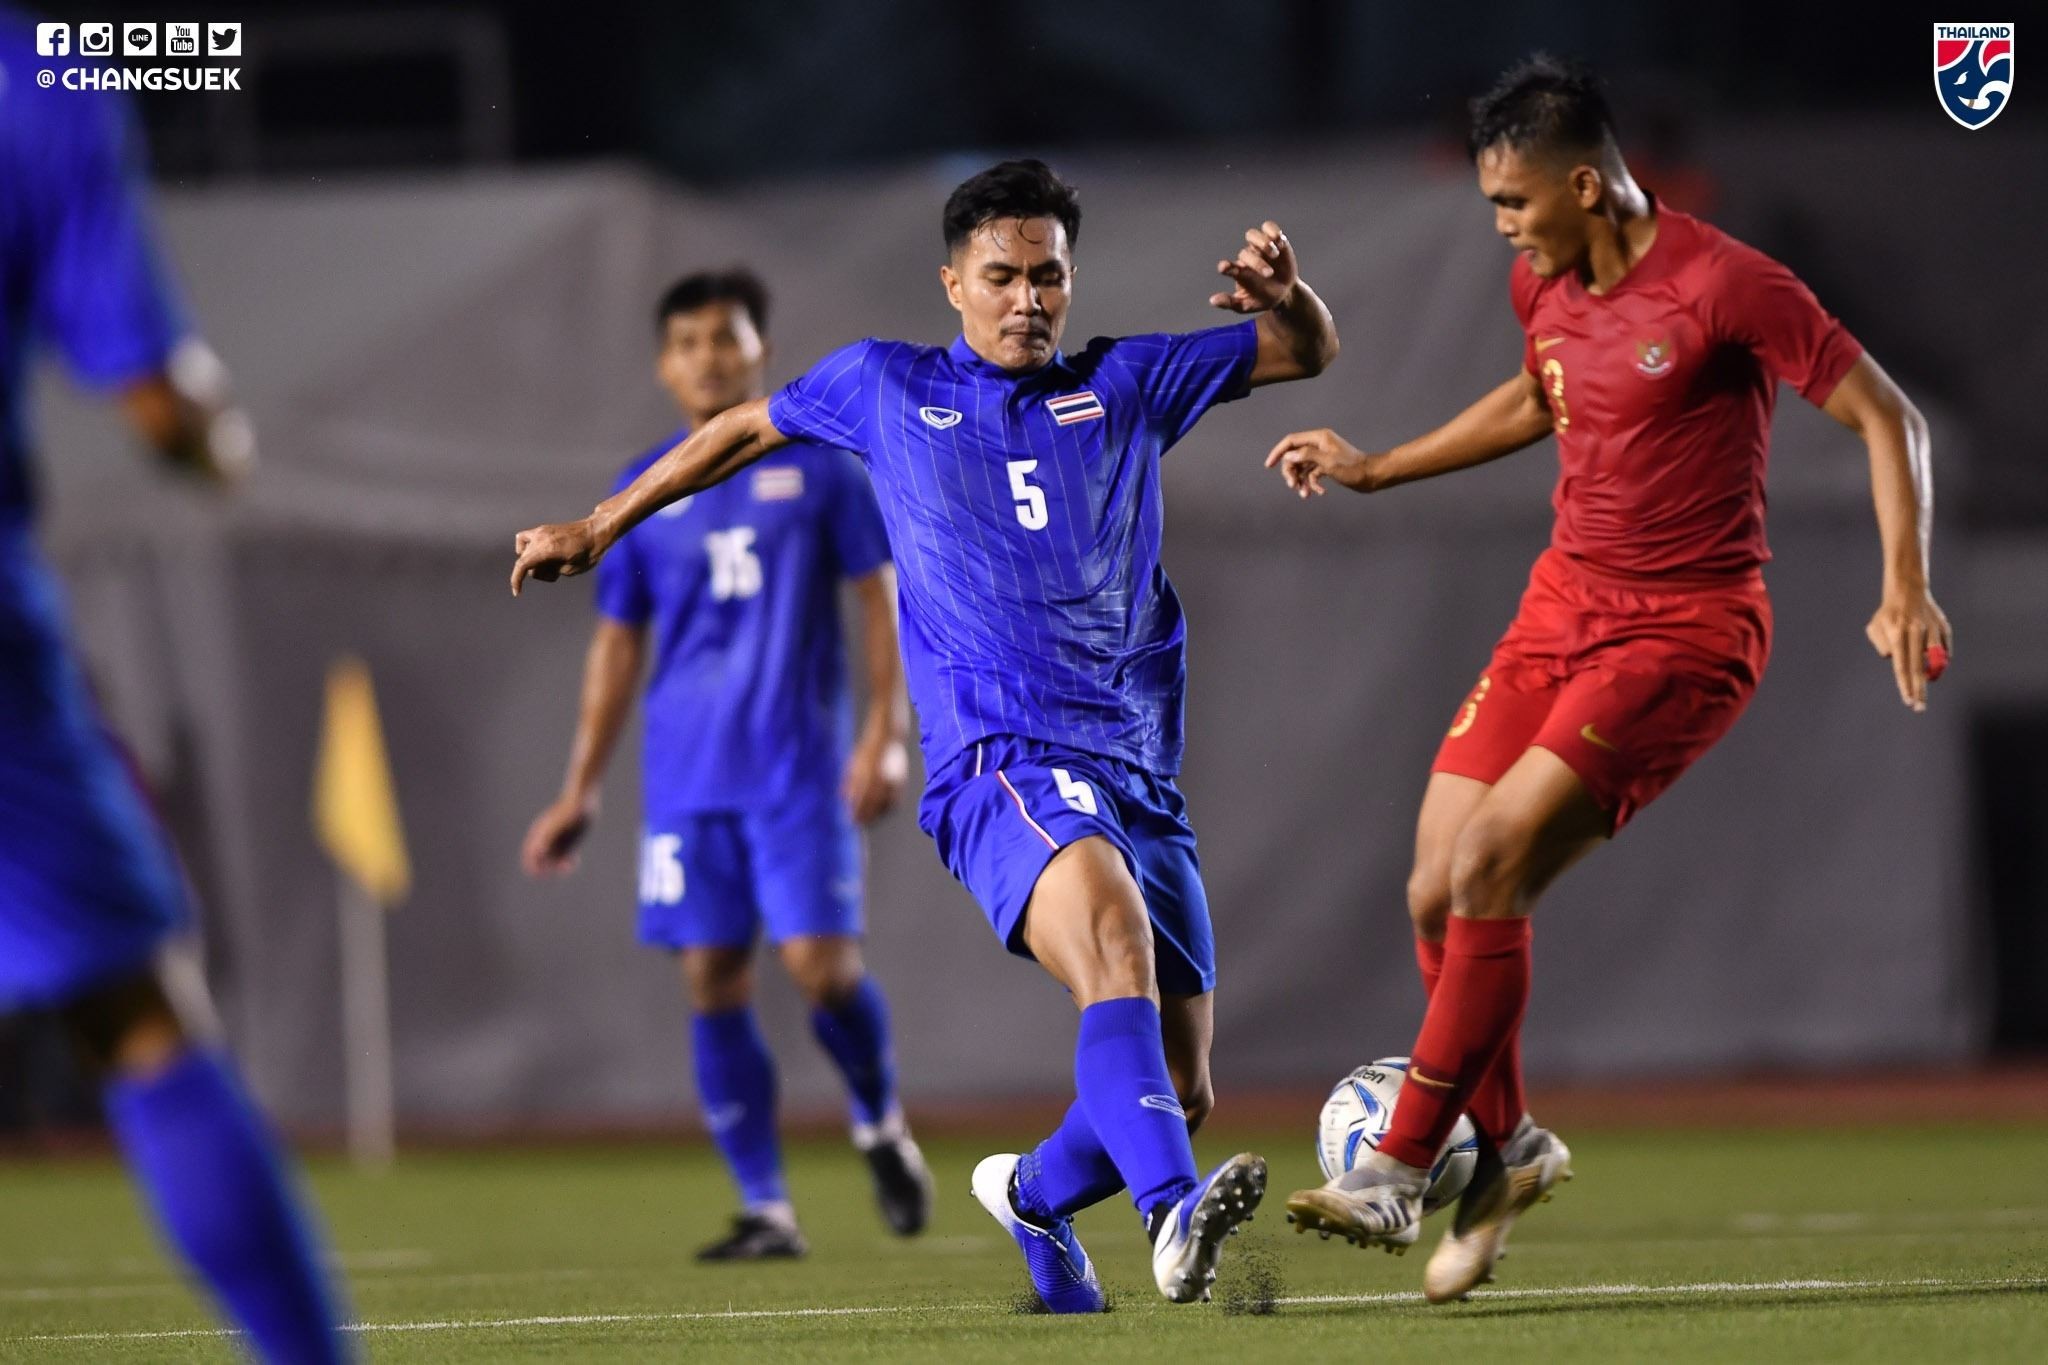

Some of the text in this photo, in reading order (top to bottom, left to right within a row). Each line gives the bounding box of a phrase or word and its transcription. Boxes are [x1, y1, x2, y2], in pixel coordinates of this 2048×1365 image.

[1006, 459, 1049, 531] 5
[705, 526, 763, 602] 15
[1051, 767, 1099, 816] 5
